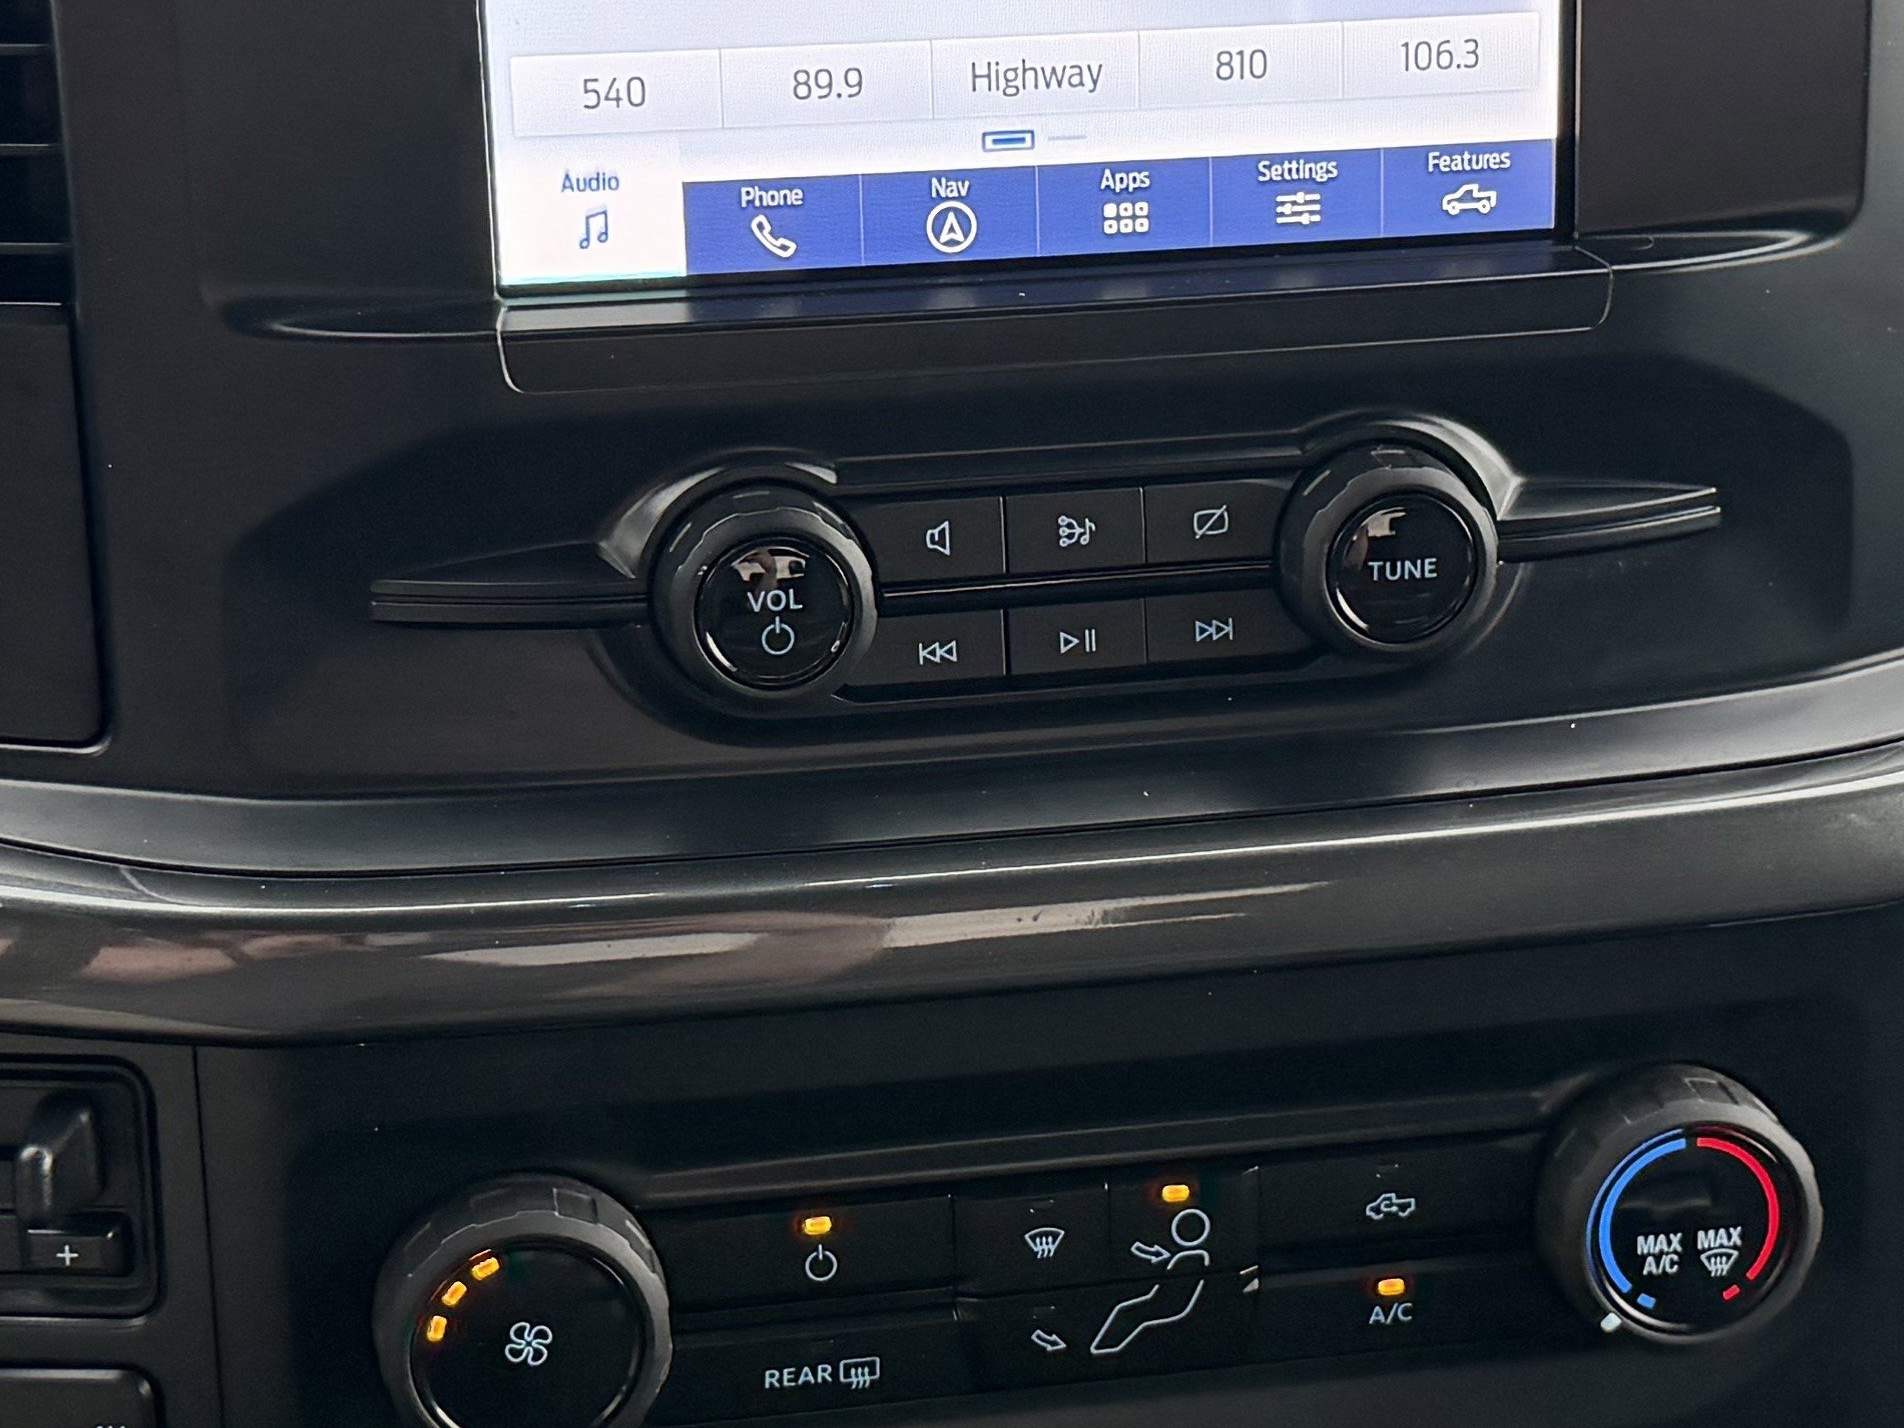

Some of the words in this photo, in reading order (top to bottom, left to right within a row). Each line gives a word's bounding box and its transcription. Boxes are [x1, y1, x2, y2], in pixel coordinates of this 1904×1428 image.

[1215, 48, 1268, 82] 810
[1401, 38, 1480, 72] 106.3
[792, 67, 863, 101] 89.9
[971, 58, 1103, 98] Highway
[583, 76, 646, 110] 540
[1257, 158, 1339, 183] Settings
[1428, 150, 1512, 173] Features
[561, 171, 620, 193] Audio
[931, 176, 970, 198] Nav
[1100, 168, 1151, 193] Apps
[740, 185, 804, 208] Phone
[1367, 557, 1438, 581] TUNE
[746, 587, 804, 613] VOL
[1636, 1232, 1683, 1256] MAX
[1697, 1225, 1742, 1250] MAX
[1642, 1251, 1679, 1276] A/C
[1368, 1301, 1413, 1325] A/C
[764, 1363, 833, 1389] REAR
